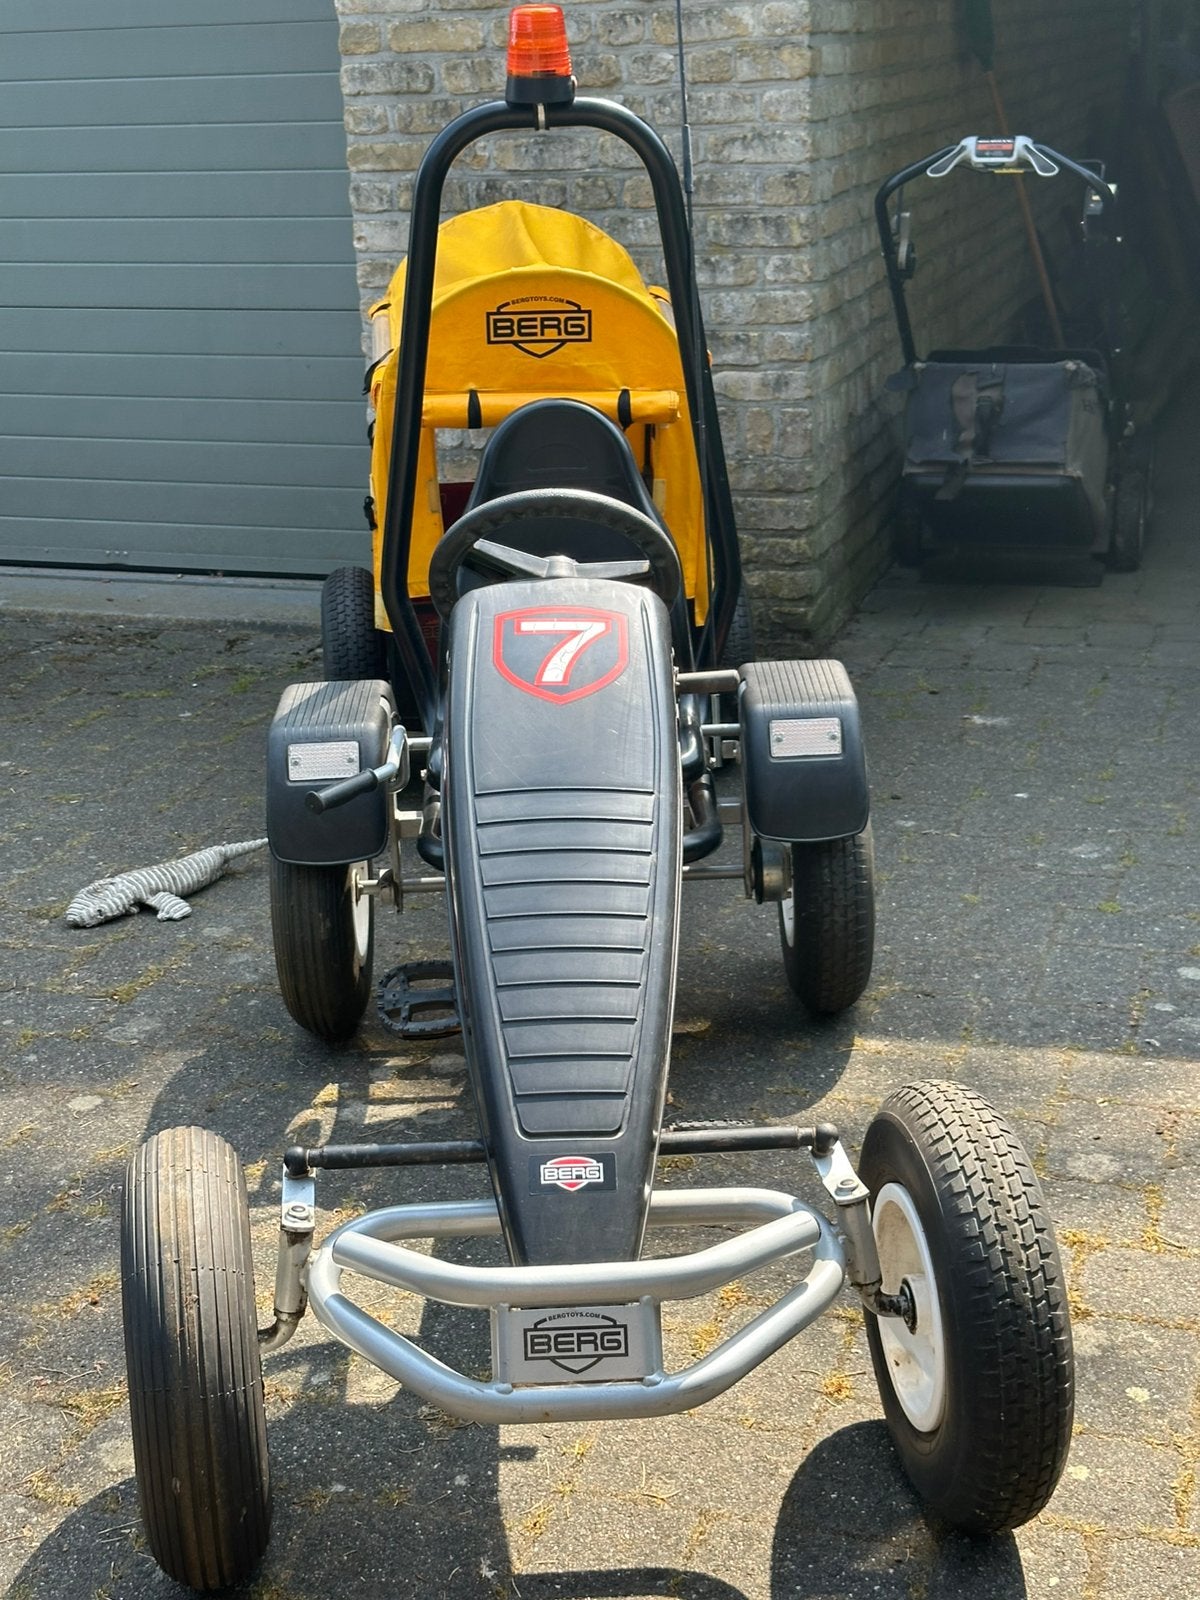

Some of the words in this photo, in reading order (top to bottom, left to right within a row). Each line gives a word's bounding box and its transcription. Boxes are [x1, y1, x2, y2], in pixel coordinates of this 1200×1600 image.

[511, 295, 565, 305] BERGTOYS.COM
[493, 316, 586, 338] BERG
[514, 618, 612, 686] 7
[544, 1166, 600, 1180] BERG
[548, 1311, 601, 1321] BERGTOYS.COM
[529, 1331, 622, 1354] BERG
